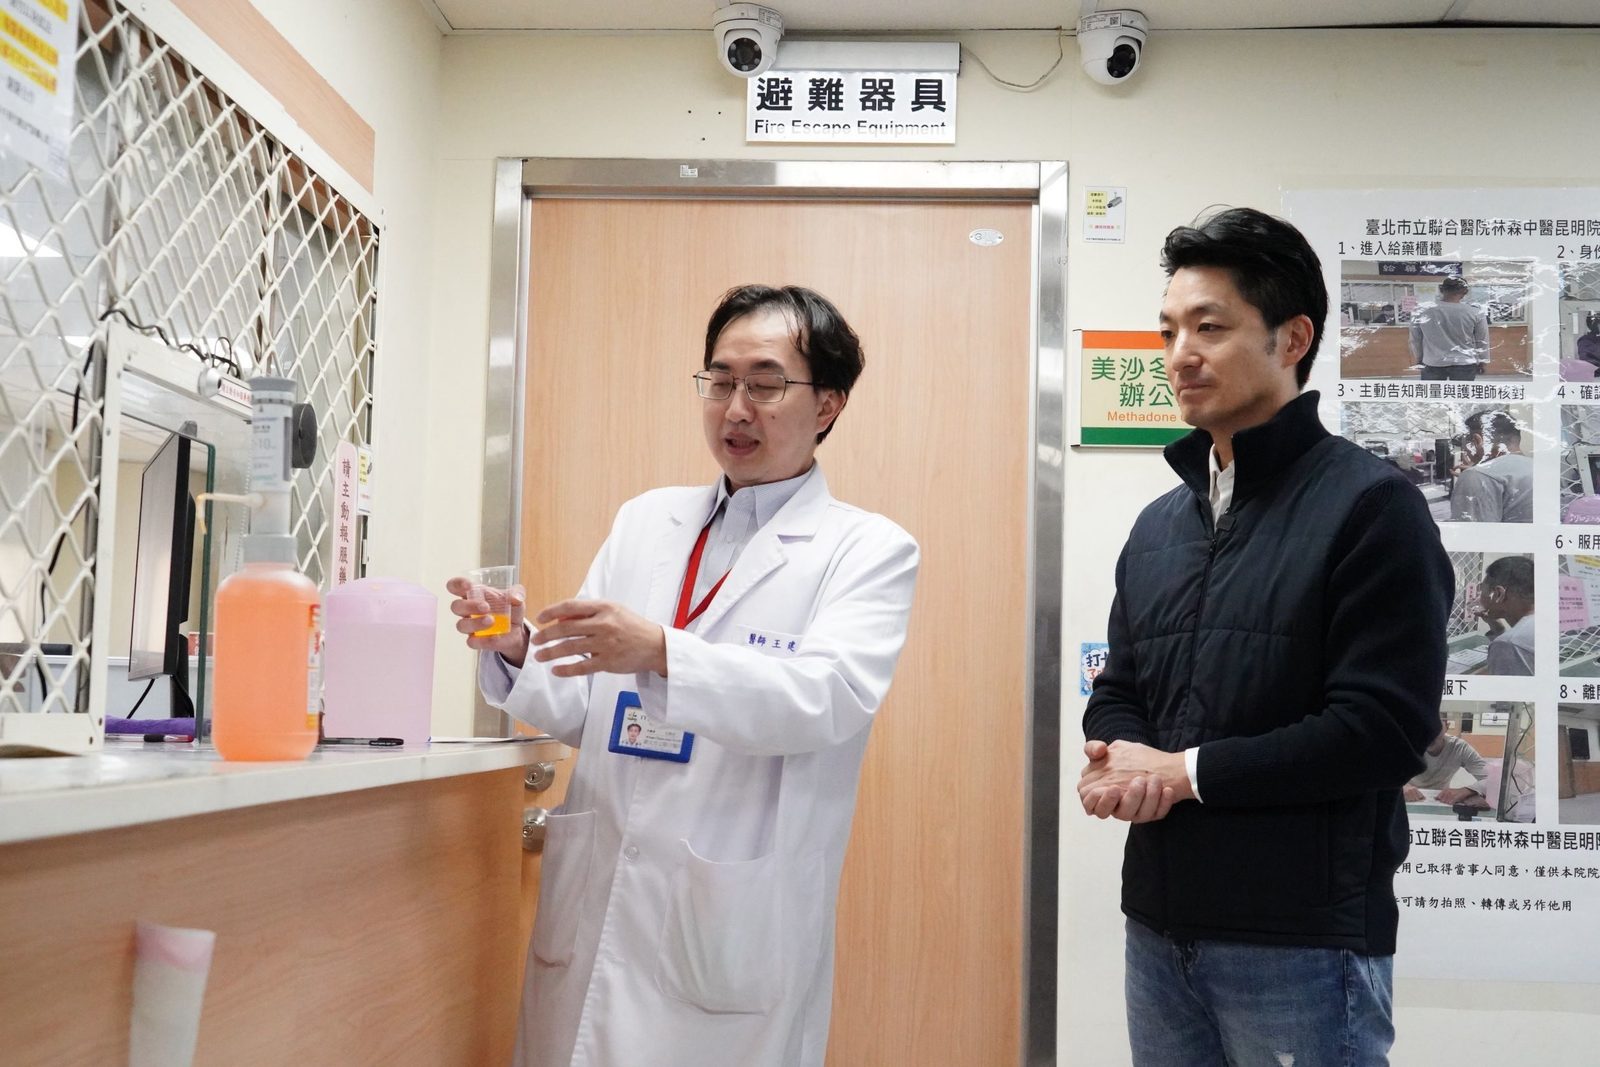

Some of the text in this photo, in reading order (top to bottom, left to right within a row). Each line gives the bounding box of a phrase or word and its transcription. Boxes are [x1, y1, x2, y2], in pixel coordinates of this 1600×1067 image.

[756, 77, 947, 112] 避難器具
[754, 119, 946, 137] Fire Escape Equipment
[1091, 356, 1169, 381] 美沙冬
[1119, 382, 1174, 407] 辦公
[1107, 411, 1177, 422] Methadone
[1559, 683, 1600, 700] 8、離
[1396, 862, 1600, 879] 用已取得當事人同意，僅供本院院
